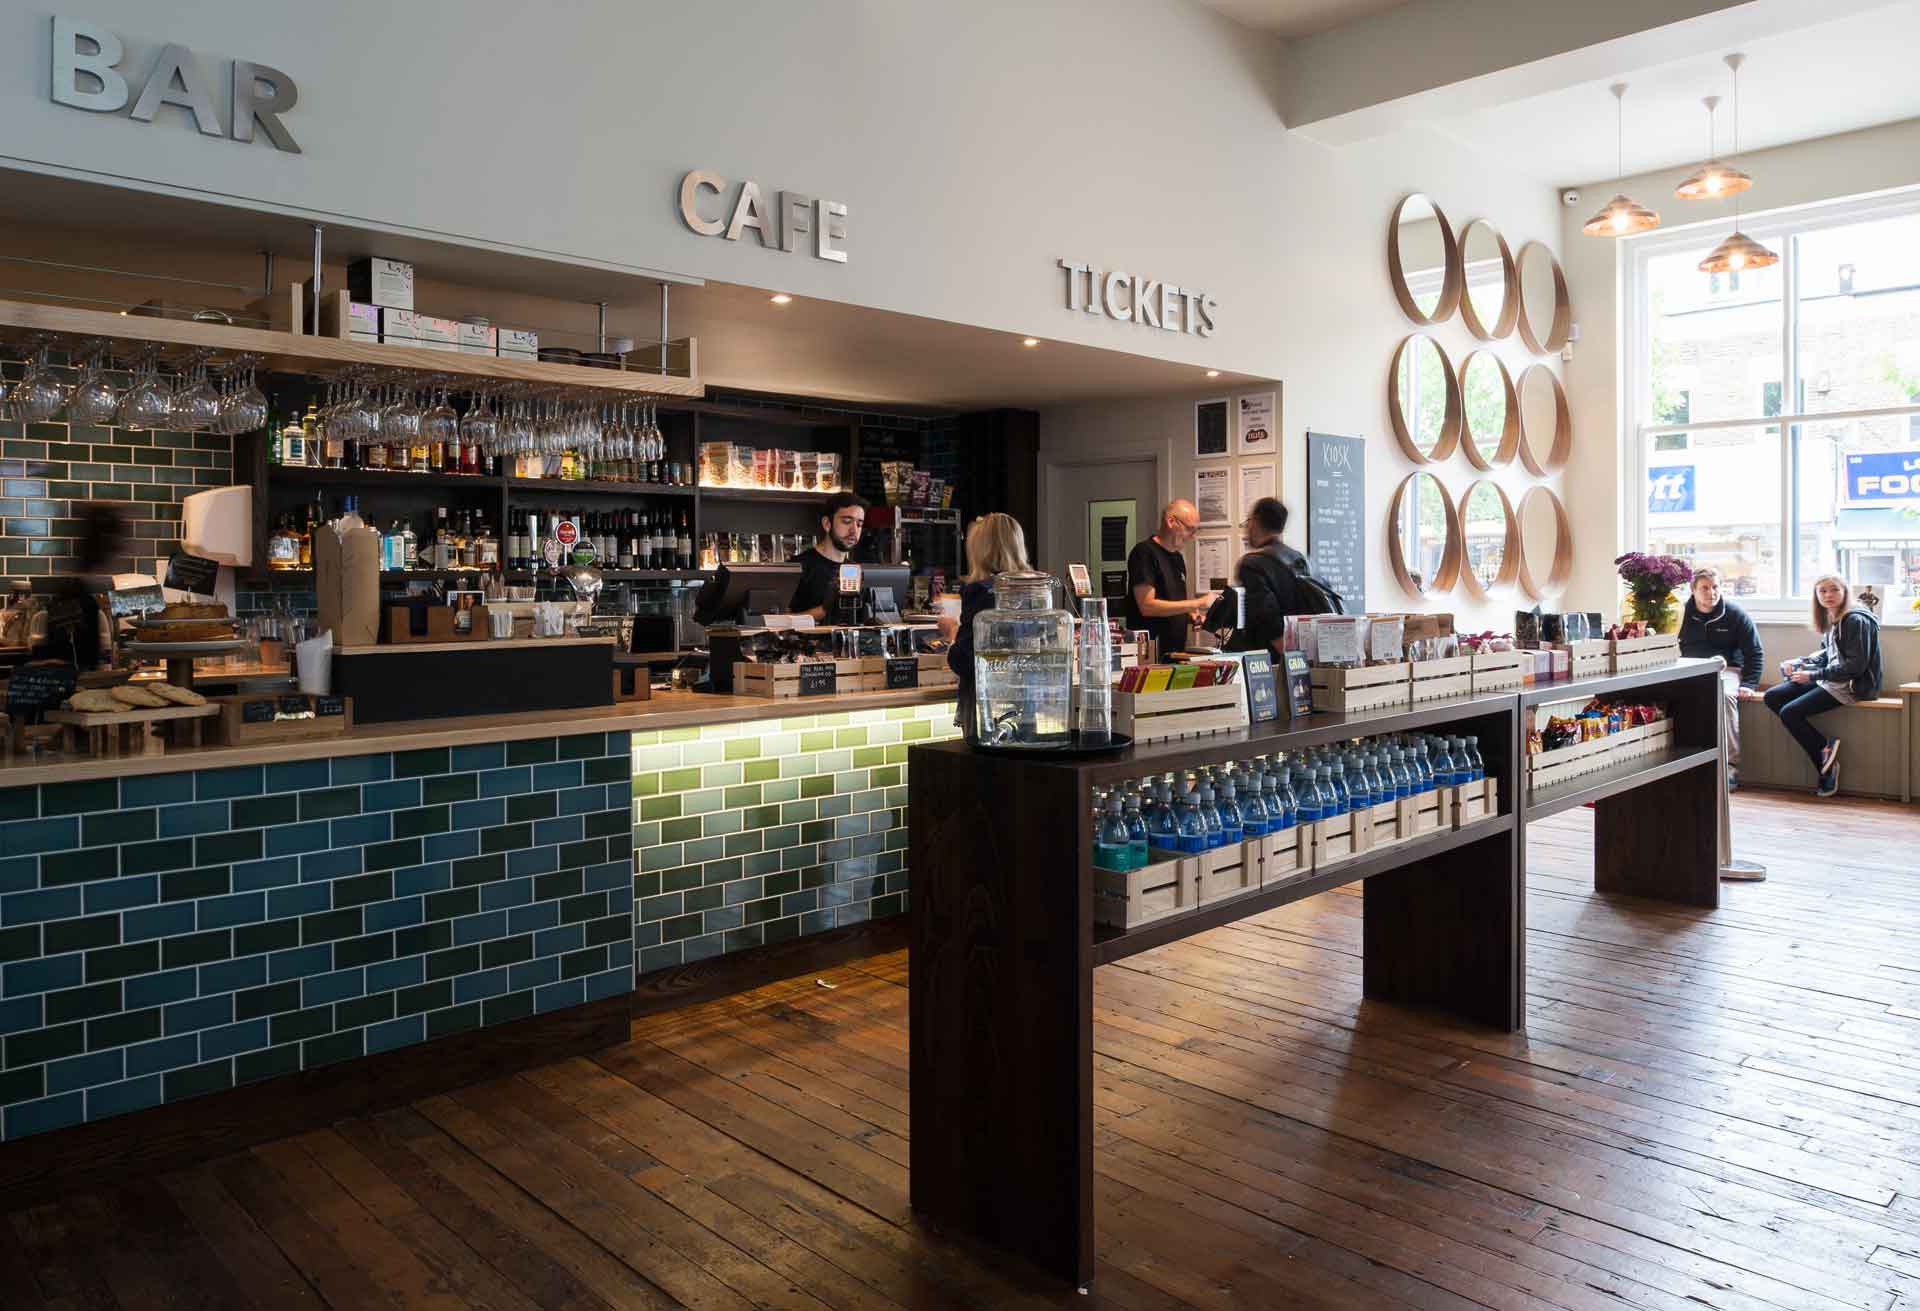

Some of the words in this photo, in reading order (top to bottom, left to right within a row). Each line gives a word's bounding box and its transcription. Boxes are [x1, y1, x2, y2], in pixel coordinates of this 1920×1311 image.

[49, 14, 303, 154] BAR
[677, 169, 849, 265] CAFE
[1056, 256, 1217, 338] TICKETS
[1322, 442, 1353, 473] KIOSK
